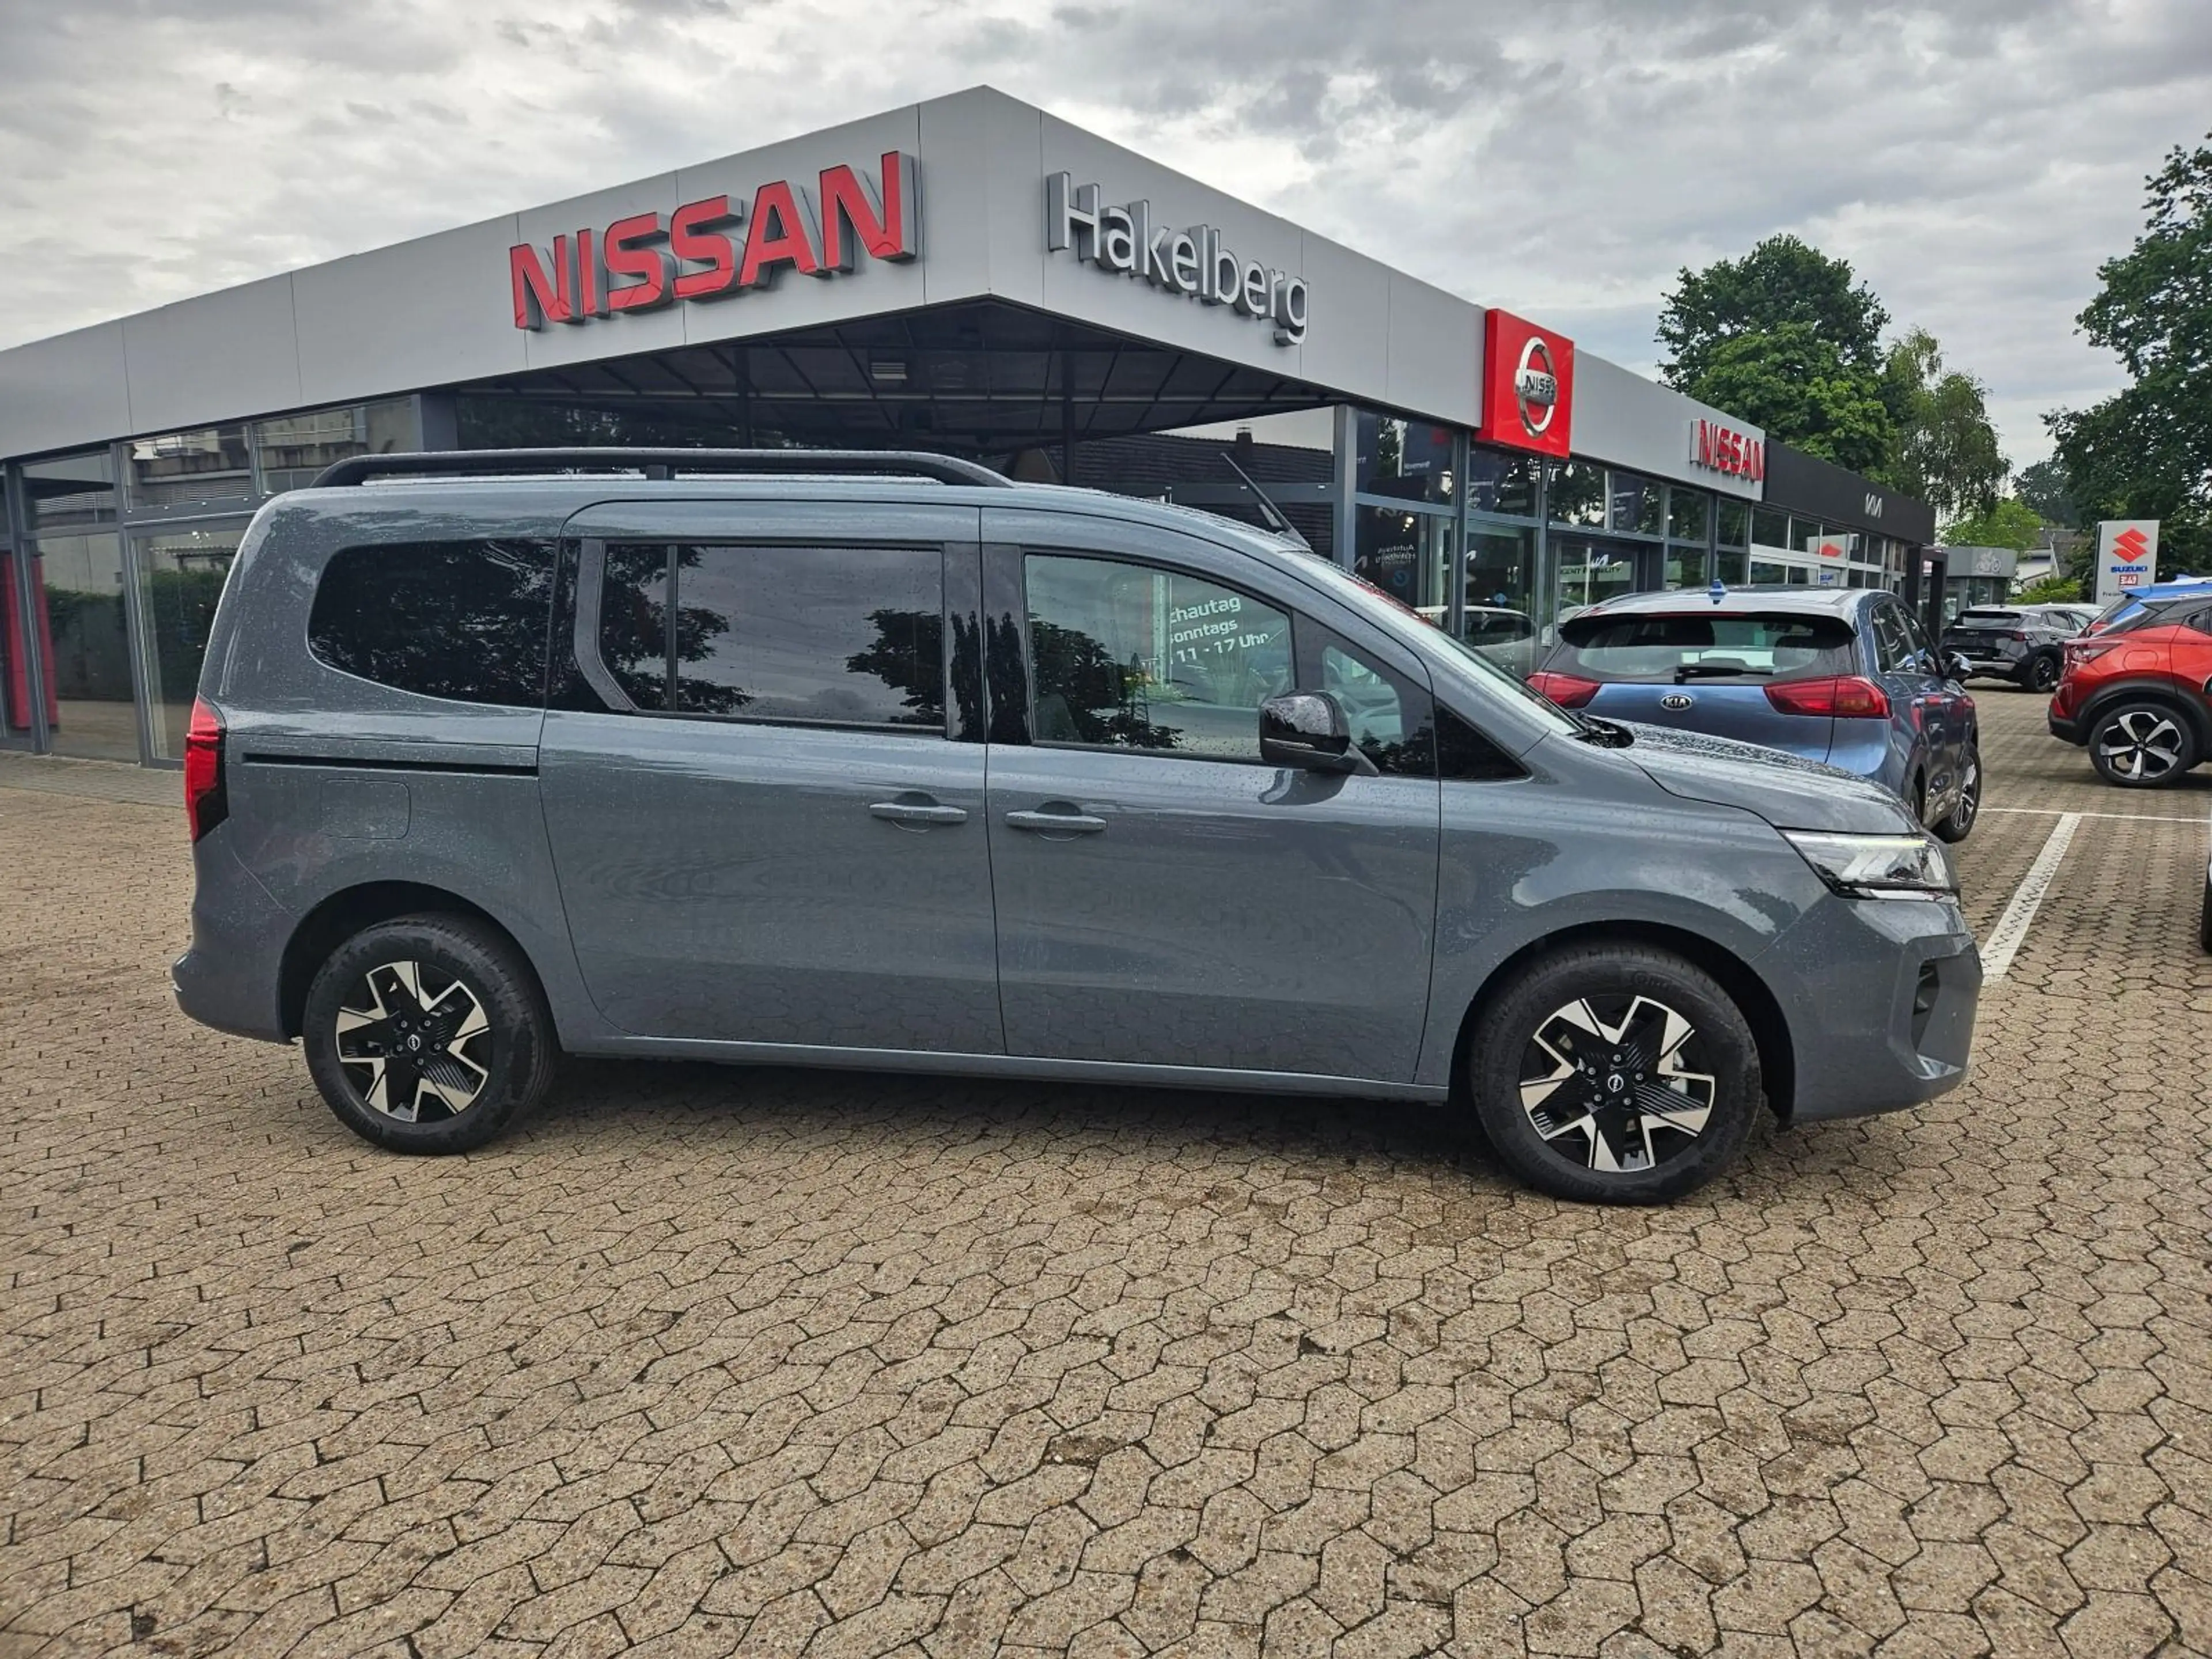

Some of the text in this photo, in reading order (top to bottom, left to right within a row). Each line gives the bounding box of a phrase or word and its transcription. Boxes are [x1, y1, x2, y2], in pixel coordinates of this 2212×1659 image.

[509, 150, 910, 330] NISSAN
[1048, 171, 1309, 346] Hakelberg
[1699, 419, 1764, 482] NISSAN
[2111, 565, 2148, 573] SUZUKI
[1176, 647, 1197, 662] 11
[1214, 638, 1236, 654] 17
[1239, 633, 1269, 648] Uhr
[1665, 697, 1687, 708] KIA
